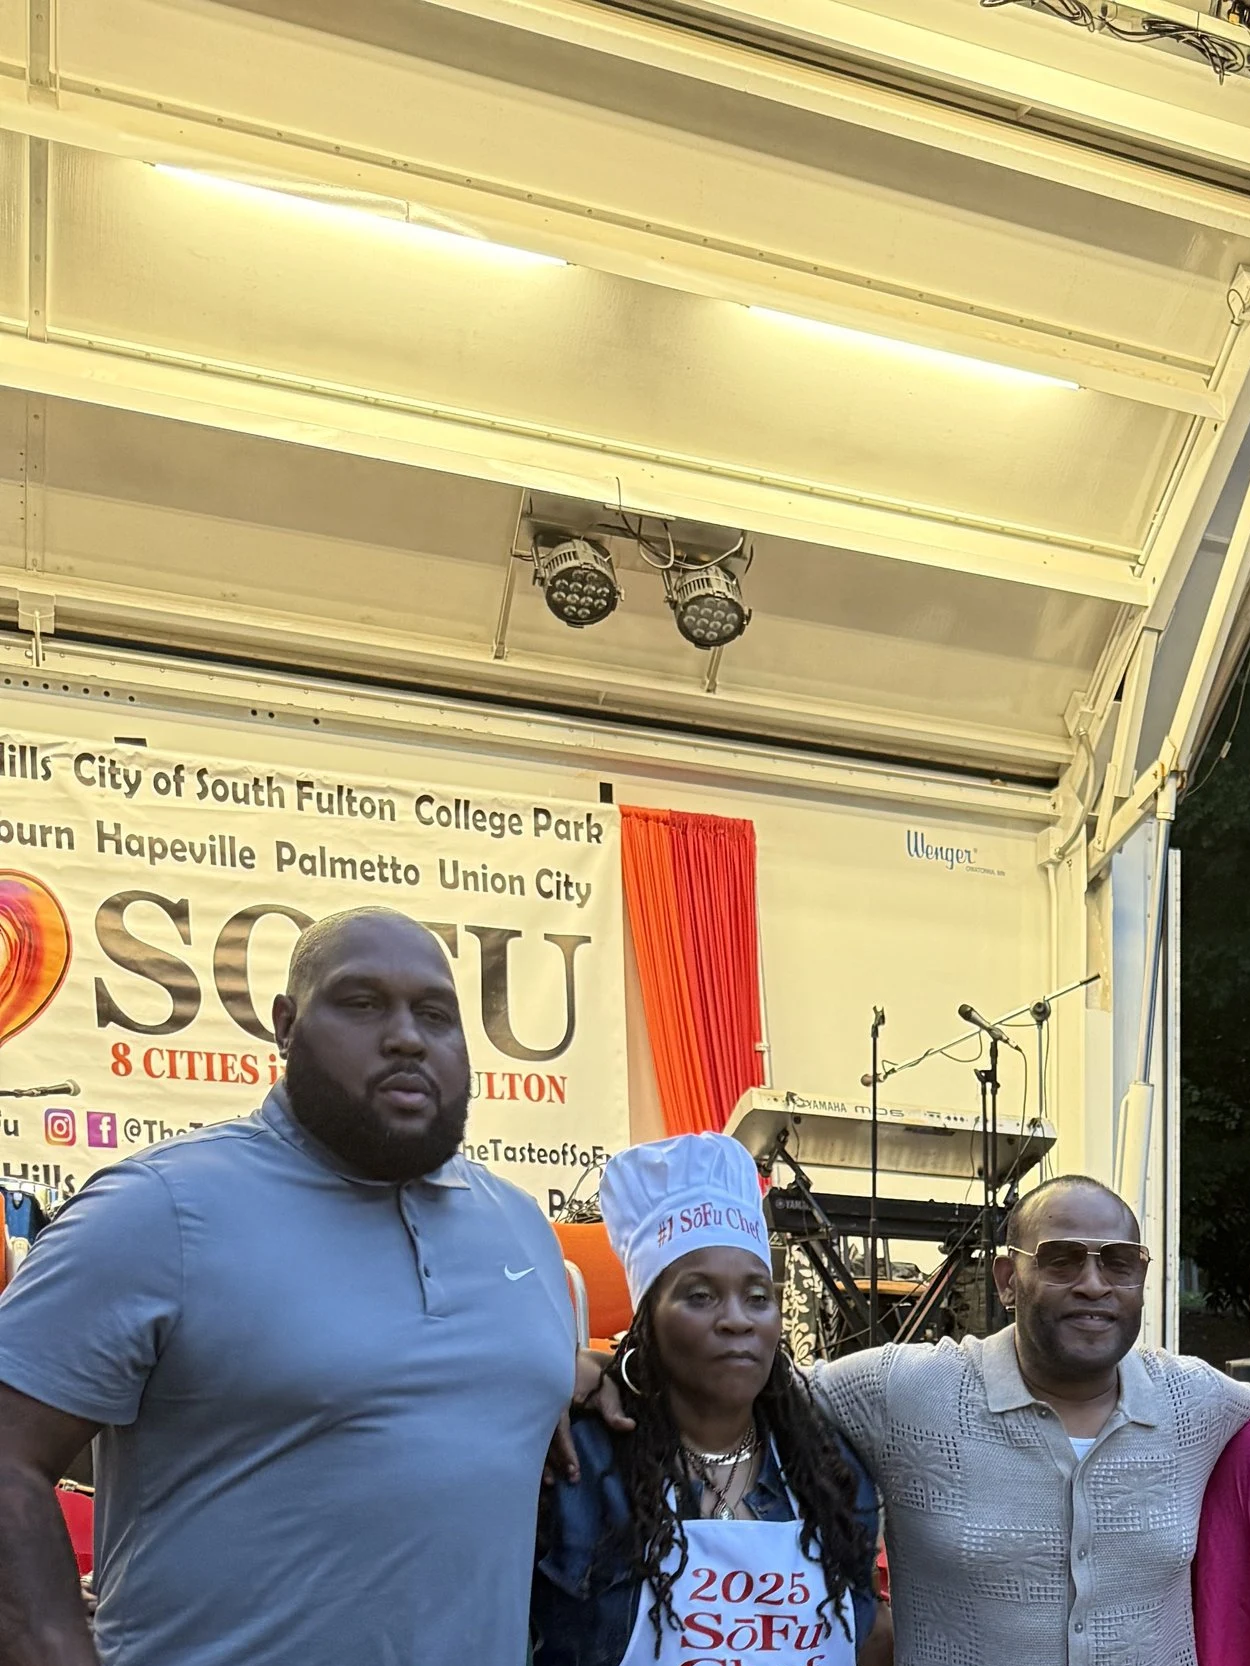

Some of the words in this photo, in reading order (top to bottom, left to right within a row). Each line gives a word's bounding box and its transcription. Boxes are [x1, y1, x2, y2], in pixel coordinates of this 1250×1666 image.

[0, 741, 52, 781] ills
[74, 752, 142, 799] City
[153, 764, 185, 797] of
[196, 767, 285, 808] South
[296, 780, 396, 821] Fulton
[415, 794, 523, 839] College
[533, 807, 603, 844] Park
[96, 820, 256, 870] Hapeville
[275, 840, 420, 885] Palmetto
[439, 858, 525, 896] Union
[535, 868, 592, 908] City
[95, 888, 592, 1062] SOU
[111, 1042, 132, 1077] 8
[143, 1048, 260, 1085] CITIES
[807, 1099, 848, 1113] YAMAHA
[657, 1215, 674, 1248] #1
[726, 1207, 761, 1244] Chef
[689, 1568, 810, 1606] 2025
